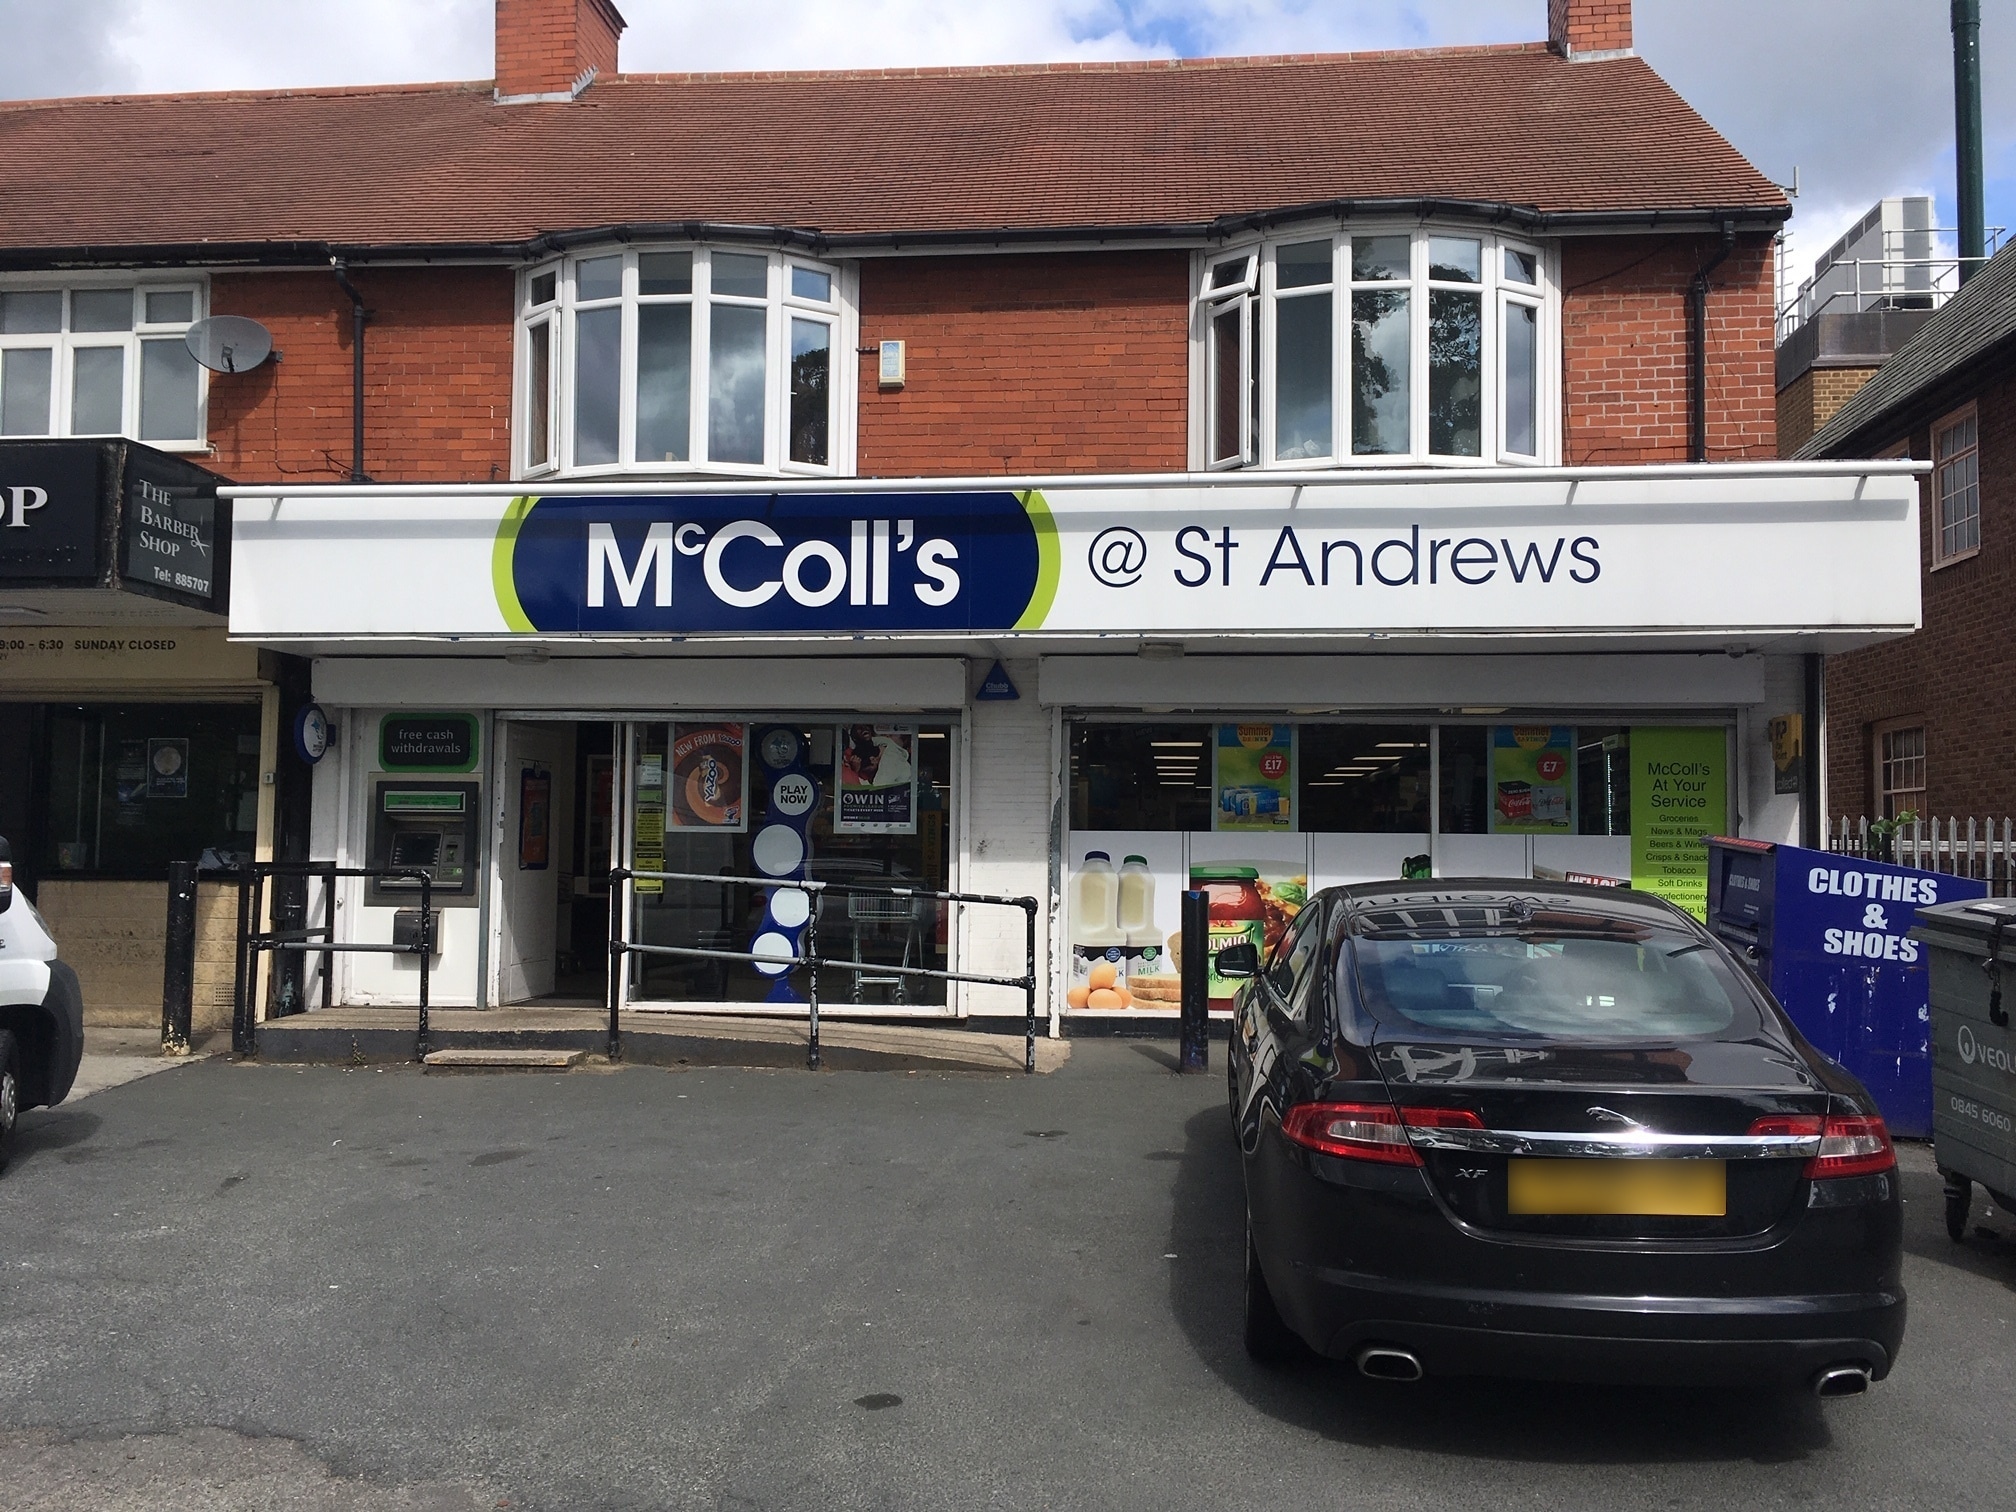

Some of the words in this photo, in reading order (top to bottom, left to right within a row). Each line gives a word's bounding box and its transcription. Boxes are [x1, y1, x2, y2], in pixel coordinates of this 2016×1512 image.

[139, 479, 171, 507] THE
[0, 486, 48, 527] P
[140, 505, 203, 546] BARBER
[139, 530, 180, 557] SHOP
[587, 519, 960, 608] McColl's
[1088, 526, 1147, 588] @
[1173, 525, 1239, 588] St
[1259, 524, 1601, 587] Andrews
[153, 566, 171, 582] Tel:
[174, 572, 209, 593] 885707
[38, 640, 64, 650] 6:30
[74, 640, 125, 650] SUNDAY
[129, 640, 176, 650] CLOSED
[399, 729, 422, 739] free
[426, 729, 454, 740] cash
[391, 742, 461, 753] withdrawals
[675, 740, 693, 757] NEW
[693, 733, 716, 747] FROM
[1264, 760, 1282, 770] £17
[1543, 761, 1558, 772] £7
[1648, 762, 1710, 776] McColl's
[704, 759, 718, 801] YAZOO
[1652, 778, 1668, 791] At
[1673, 778, 1707, 791] Your
[780, 785, 808, 794] PLAY
[780, 795, 808, 804] NOW
[1651, 794, 1707, 808] Service
[1659, 814, 1699, 823] Groceries
[1651, 827, 1673, 836] News
[1676, 827, 1682, 836] &
[1685, 827, 1707, 838] Mags
[1650, 840, 1673, 848] Beers
[1675, 840, 1682, 848] &
[1646, 853, 1672, 863] Crisps
[1674, 853, 1680, 862] &
[1662, 866, 1697, 874] Tobacco
[1658, 879, 1674, 887] Soft
[1676, 879, 1703, 887] Drinks
[1808, 867, 1938, 905] CLOTHES
[1862, 903, 1889, 930] &
[1823, 928, 1919, 963] SHOES
[1138, 964, 1160, 976] MILK
[1977, 1043, 2016, 1075] VEOL
[1950, 1096, 1979, 1119] 0845
[1982, 1109, 2011, 1132] 6060
[1455, 1168, 1488, 1179] XF
